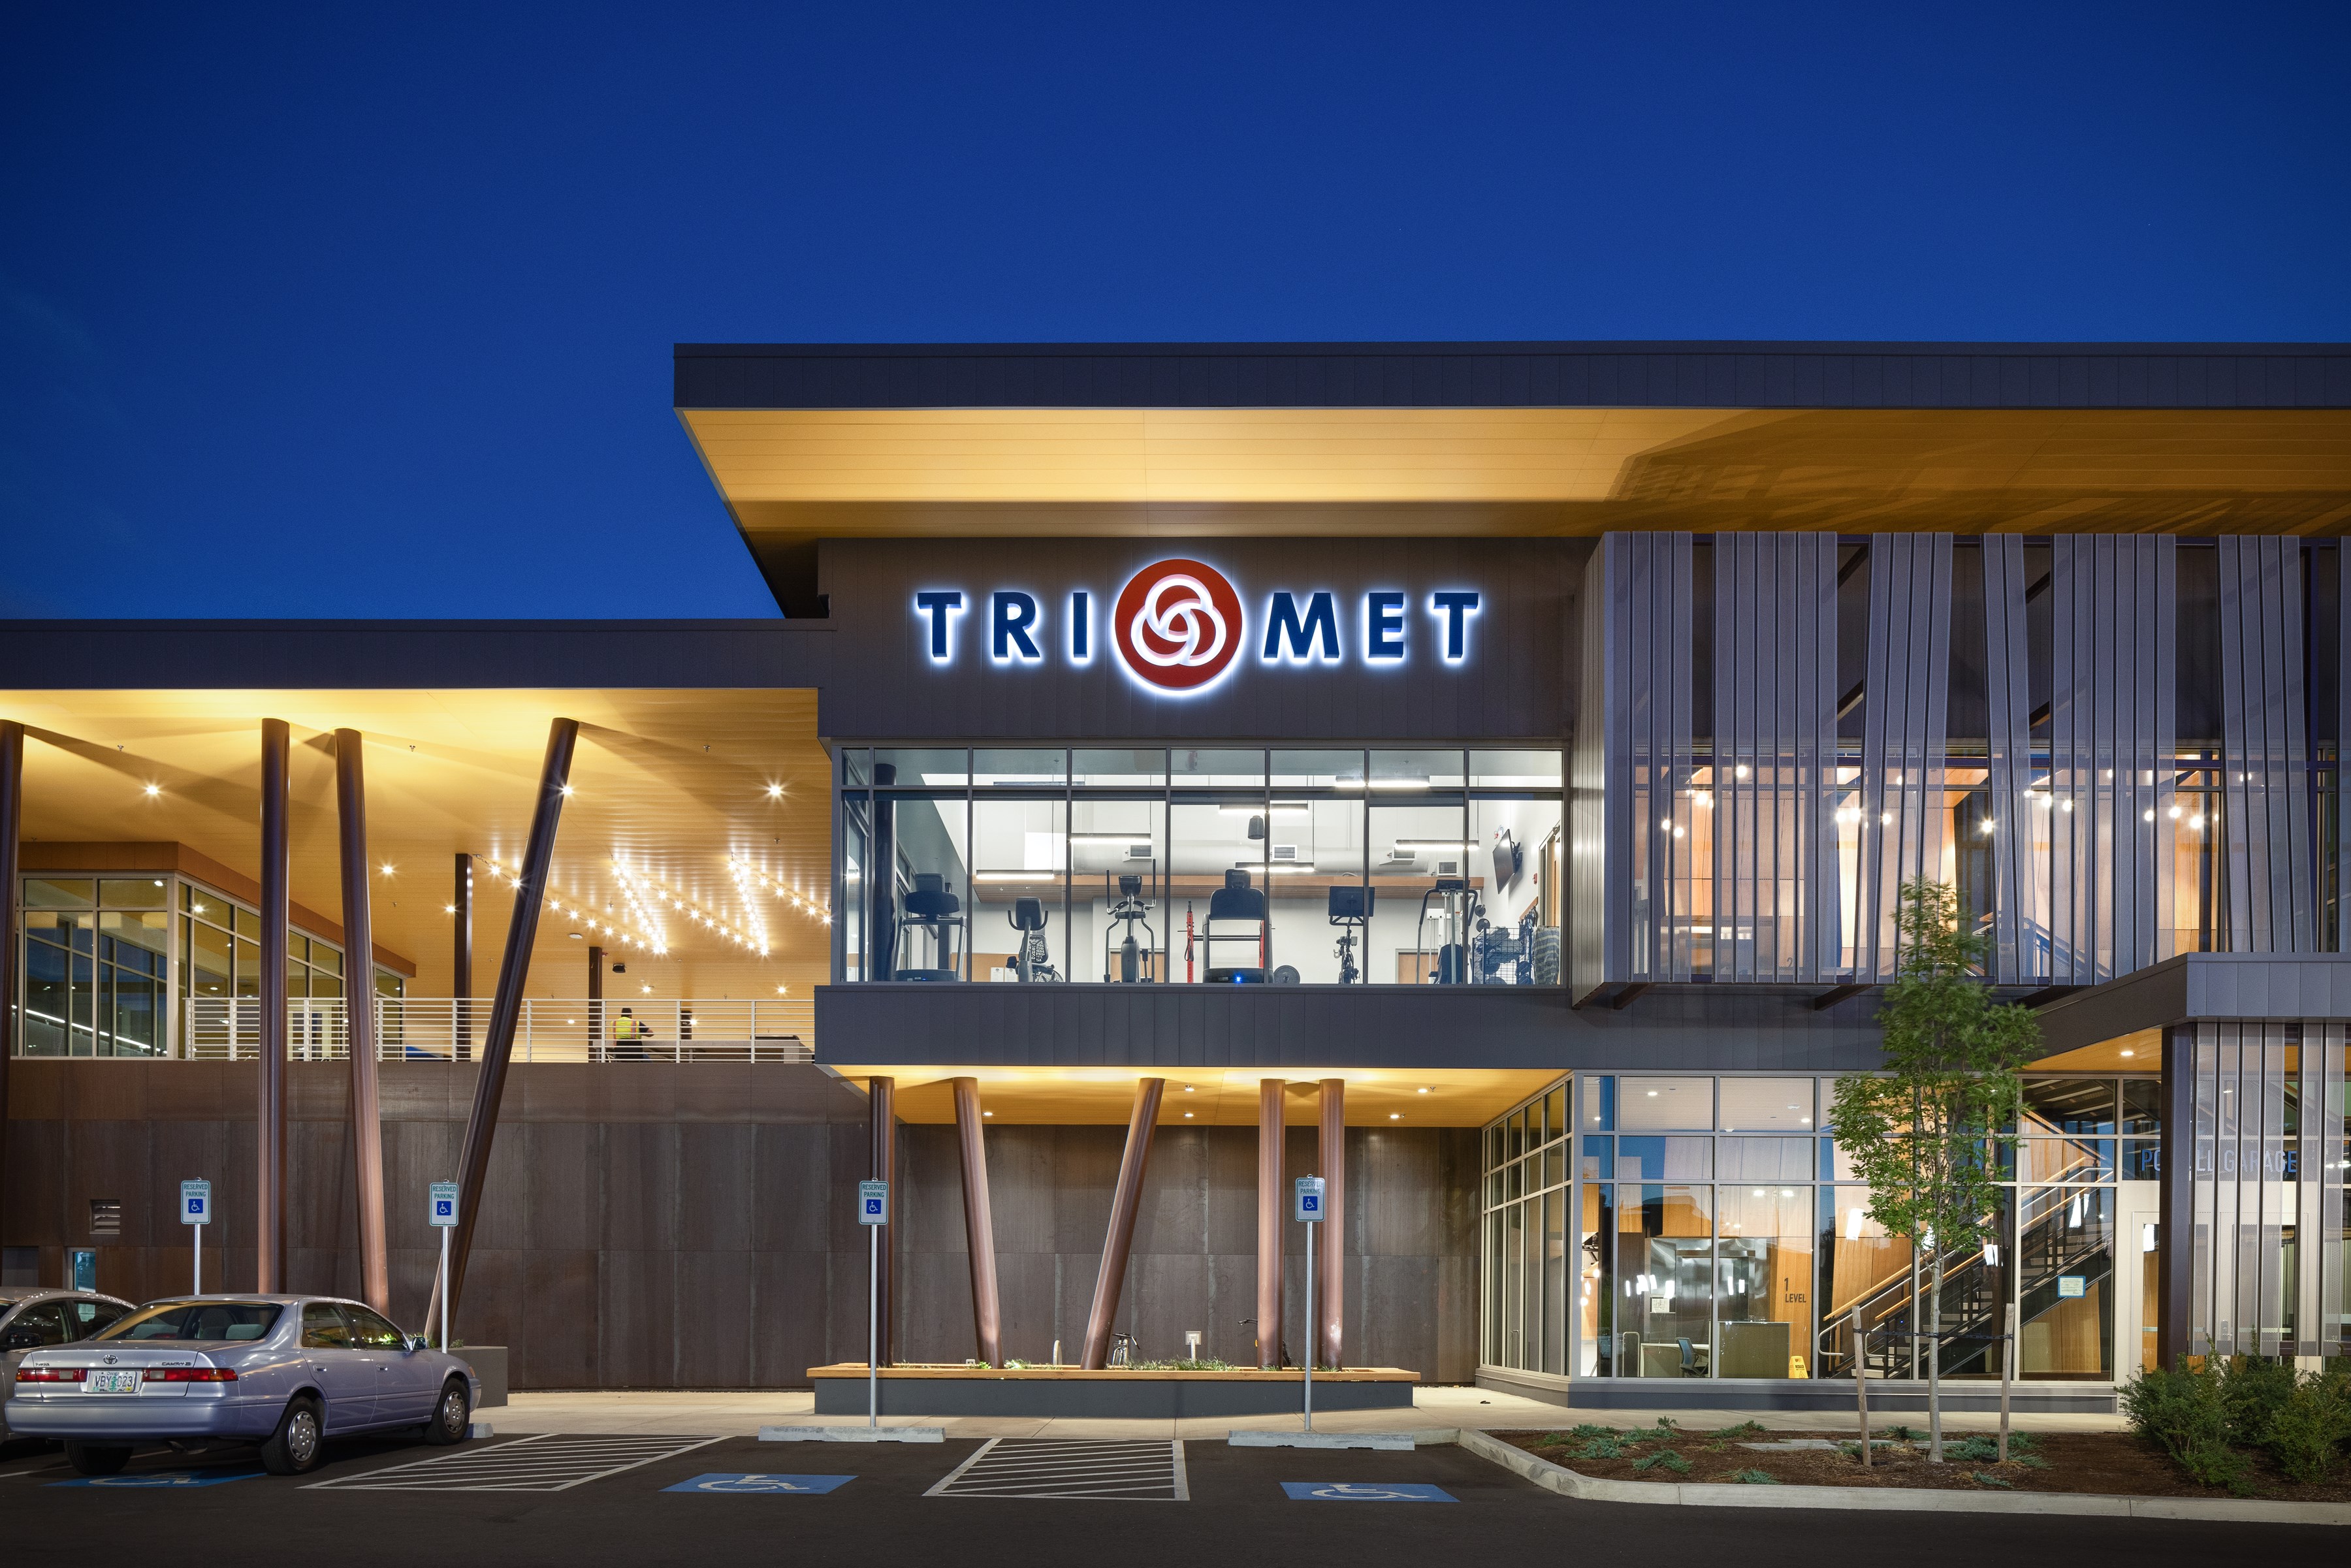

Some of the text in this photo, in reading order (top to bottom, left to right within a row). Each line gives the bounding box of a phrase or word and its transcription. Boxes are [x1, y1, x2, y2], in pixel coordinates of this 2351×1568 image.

[917, 592, 1479, 659] TRI MET
[2141, 1149, 2213, 1172] POLL
[1784, 1277, 1788, 1292] 1
[1785, 1293, 1806, 1304] LEVEL
[95, 1375, 133, 1387] VBY 023
